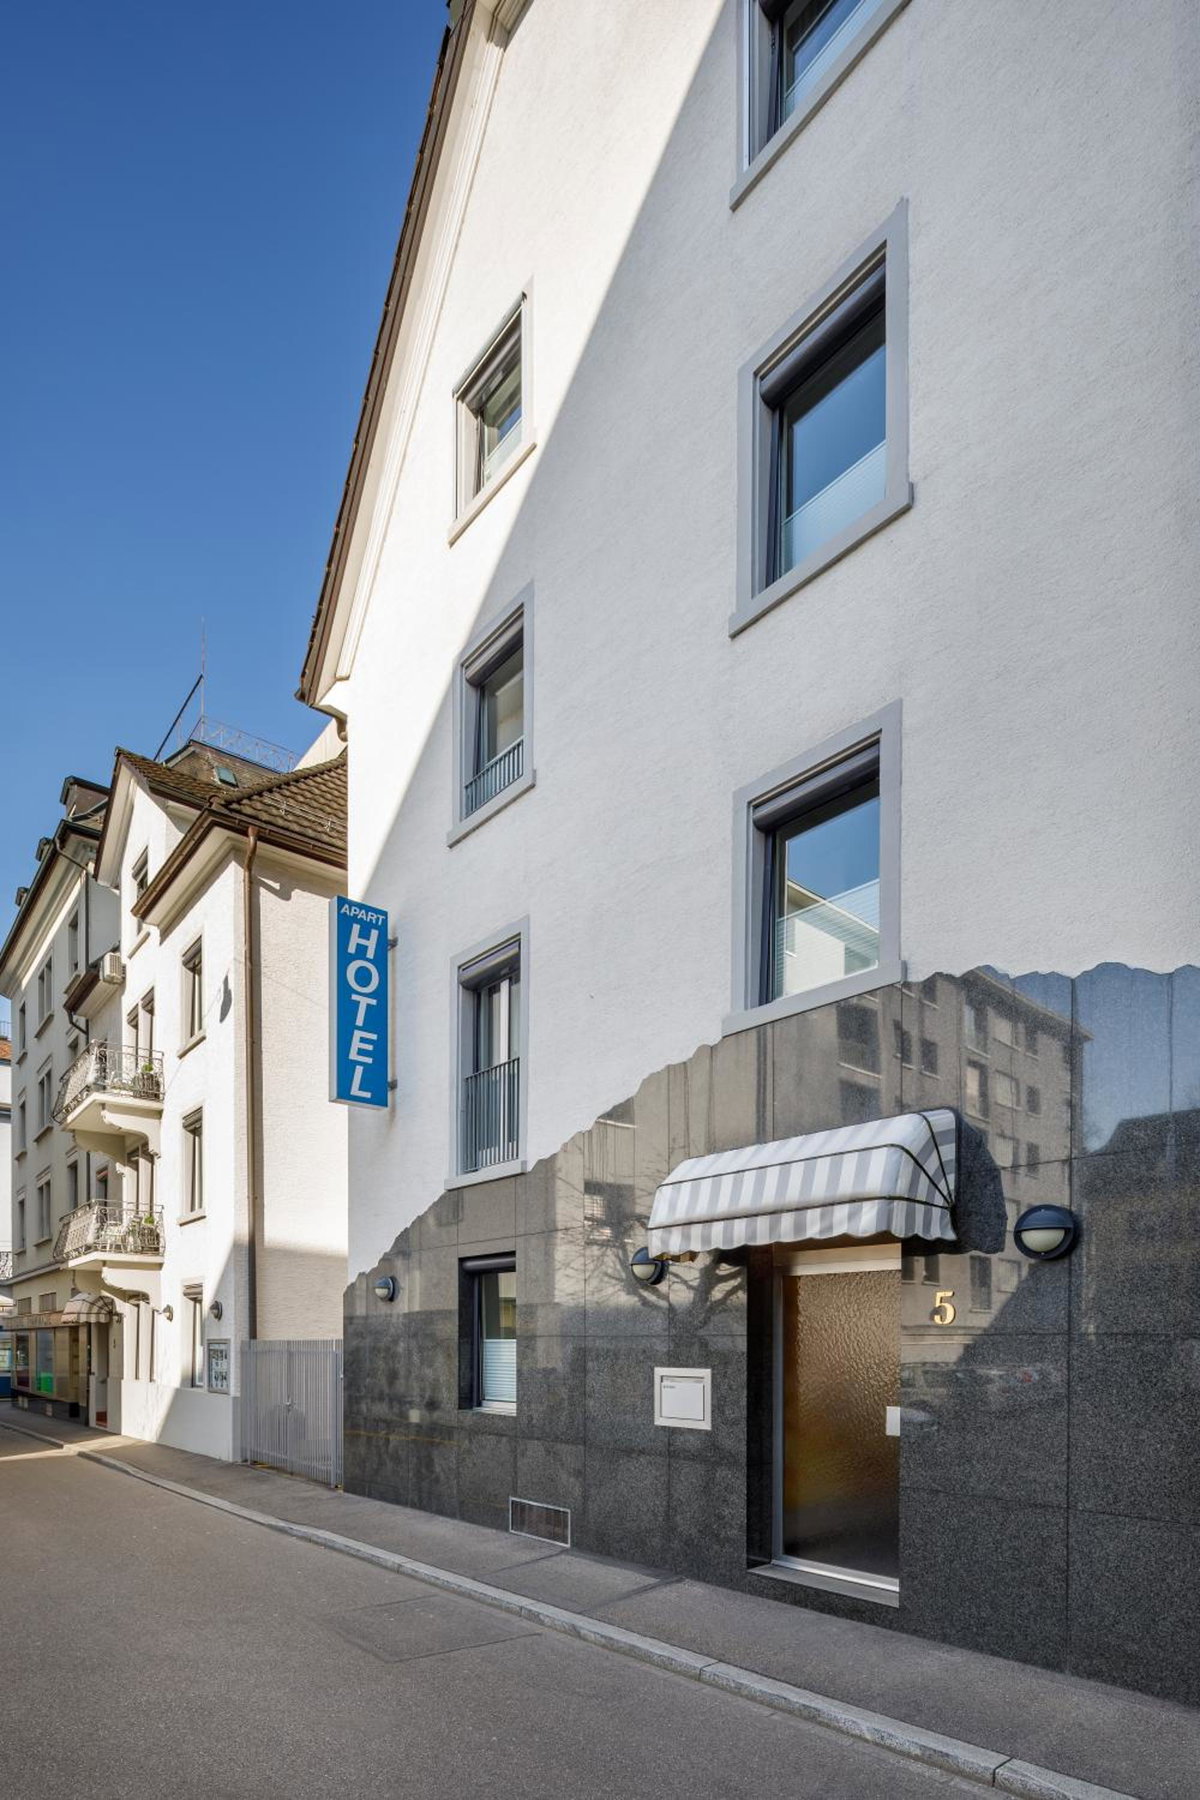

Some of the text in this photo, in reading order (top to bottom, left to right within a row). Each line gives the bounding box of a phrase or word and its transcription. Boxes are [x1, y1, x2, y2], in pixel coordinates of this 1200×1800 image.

[340, 904, 386, 926] APART
[346, 923, 380, 1099] HOTEL
[934, 1291, 956, 1325] 5
